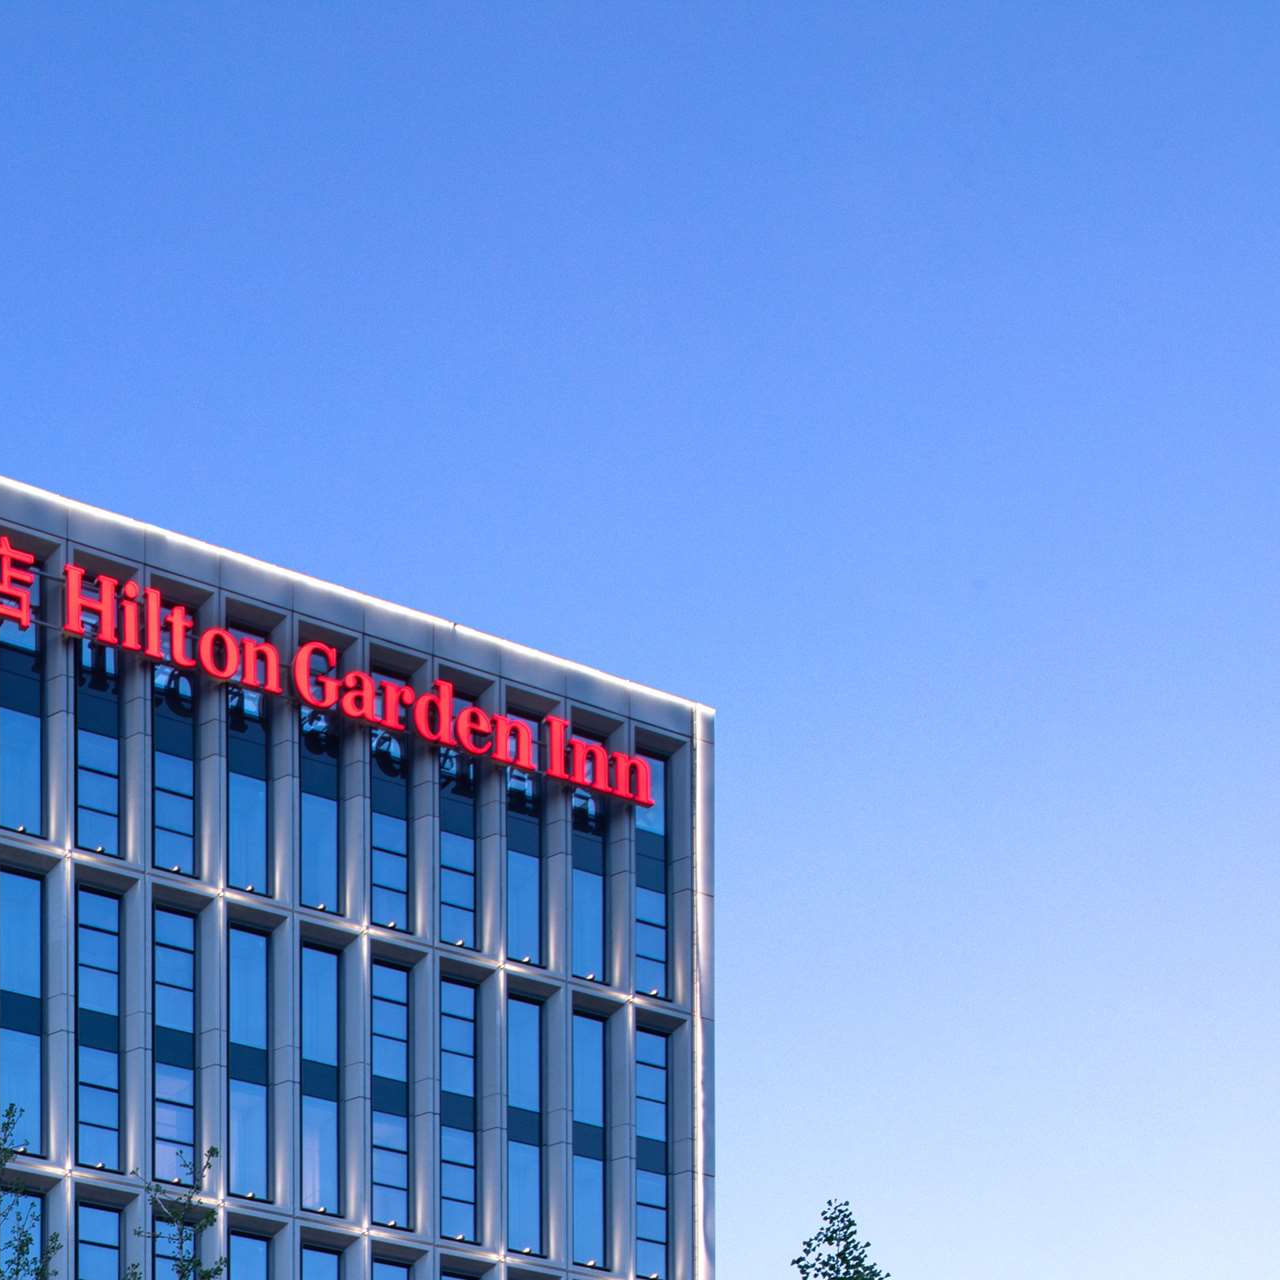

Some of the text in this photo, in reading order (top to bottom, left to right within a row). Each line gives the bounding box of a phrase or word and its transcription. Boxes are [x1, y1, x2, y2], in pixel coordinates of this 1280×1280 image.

[62, 562, 282, 696] Hilton
[292, 640, 536, 772] Garden
[544, 714, 656, 808] Inn
